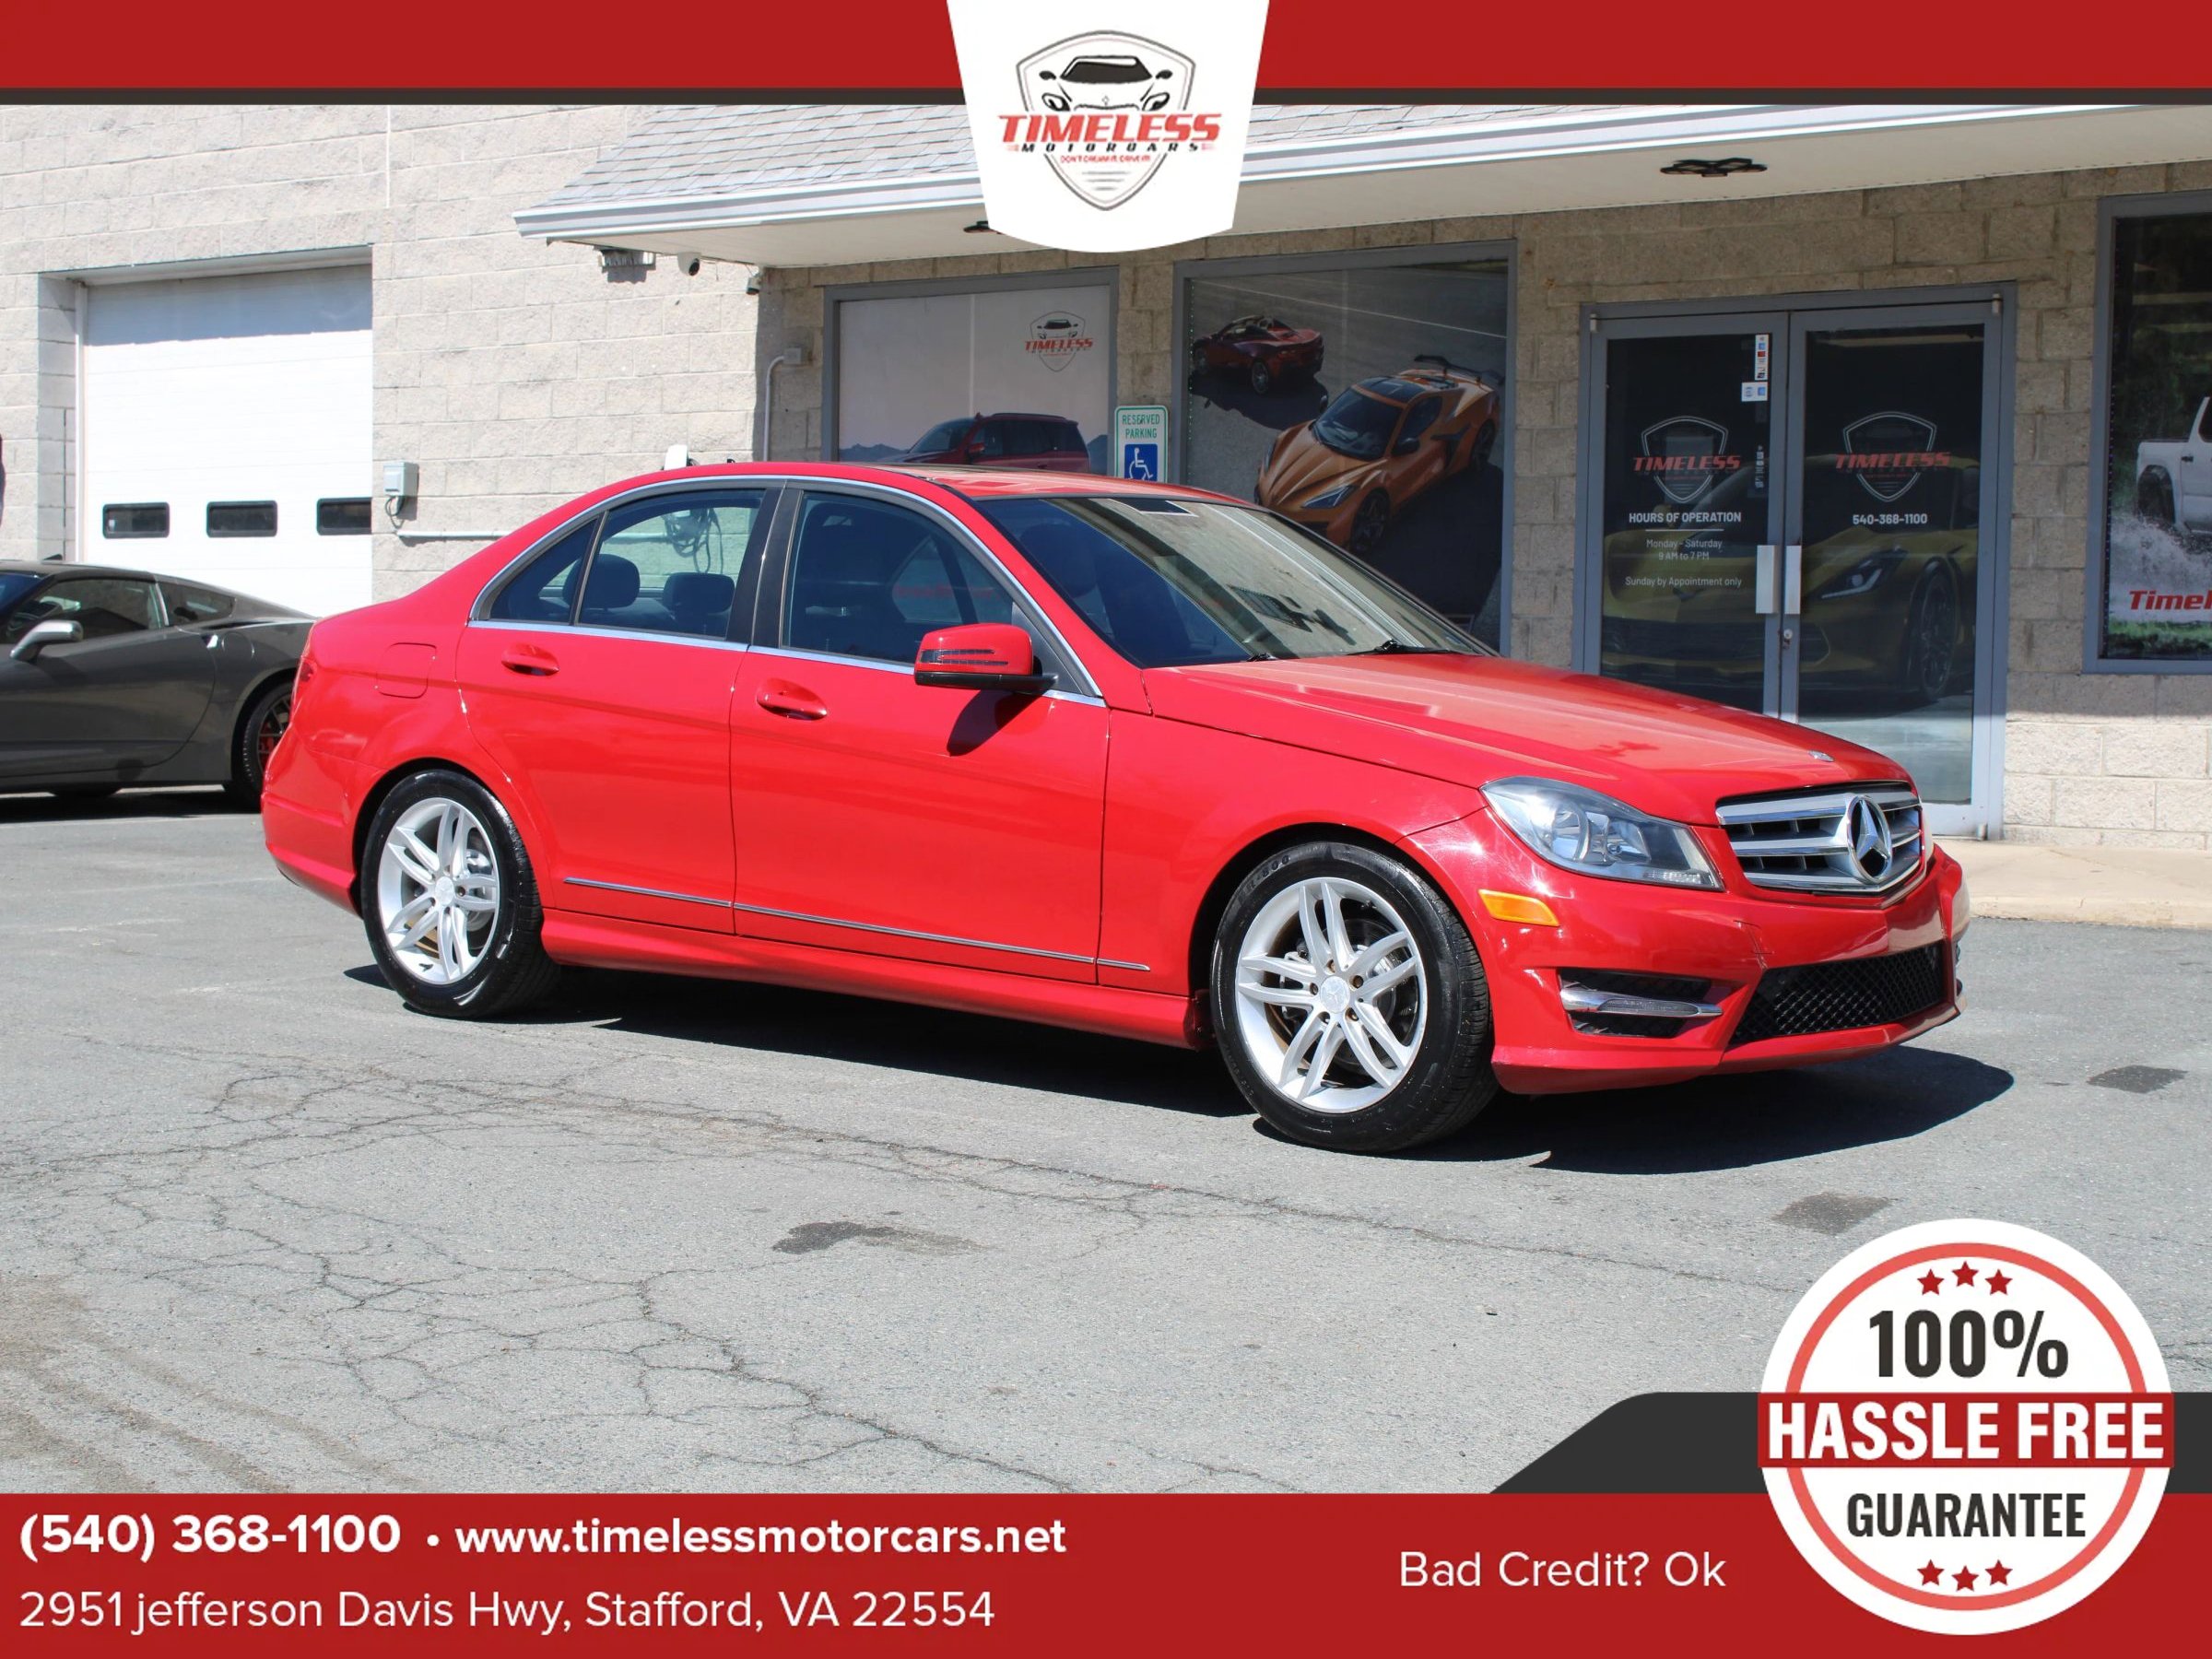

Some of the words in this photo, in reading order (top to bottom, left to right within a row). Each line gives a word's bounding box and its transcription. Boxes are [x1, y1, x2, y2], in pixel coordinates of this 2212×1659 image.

[1025, 338, 1094, 350] TIMELESS
[1122, 414, 1160, 425] RESERVED
[1124, 428, 1158, 439] PARKING
[1633, 455, 1741, 471] TIMELESS
[1835, 452, 1951, 468] TIMELESS
[1629, 512, 1664, 524] HOURS
[1665, 512, 1680, 523] OF
[1681, 512, 1742, 523] OPERATION
[1853, 513, 1928, 524] 540-368-1100
[1646, 539, 1677, 551] Monday
[1685, 539, 1724, 550] Saturday
[1665, 552, 1678, 560] AM
[1680, 551, 1688, 560] to
[1697, 551, 1710, 560] PM
[1625, 576, 1655, 588] Sunday
[1657, 576, 1667, 588] by
[1668, 577, 1724, 588] Appointment
[1724, 576, 1742, 588] only
